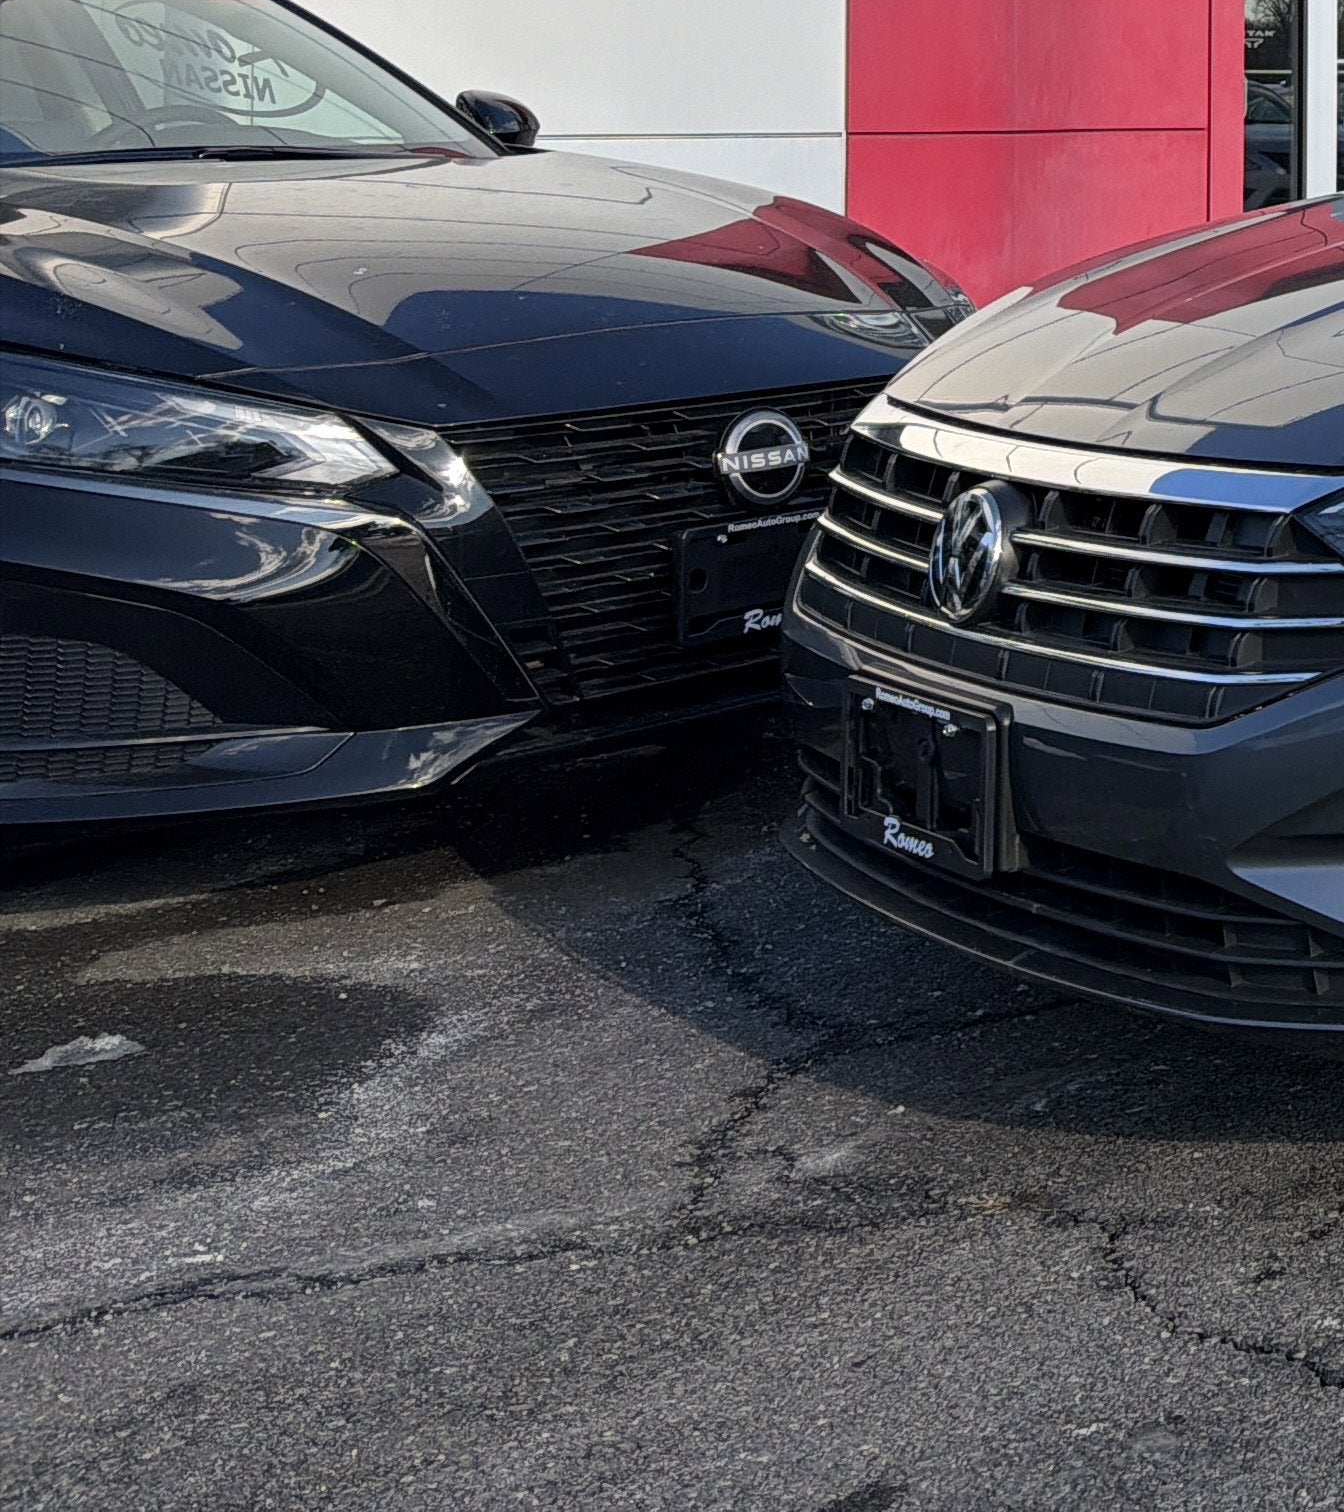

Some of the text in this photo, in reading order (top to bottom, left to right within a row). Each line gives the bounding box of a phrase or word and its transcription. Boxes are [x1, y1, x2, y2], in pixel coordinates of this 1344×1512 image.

[722, 441, 810, 473] NISSAN
[727, 509, 821, 534] RomeoAutoGroup.com
[743, 608, 783, 634] Rom
[875, 686, 951, 722] RomeoAutoGroup.com
[883, 815, 936, 859] Romeo
